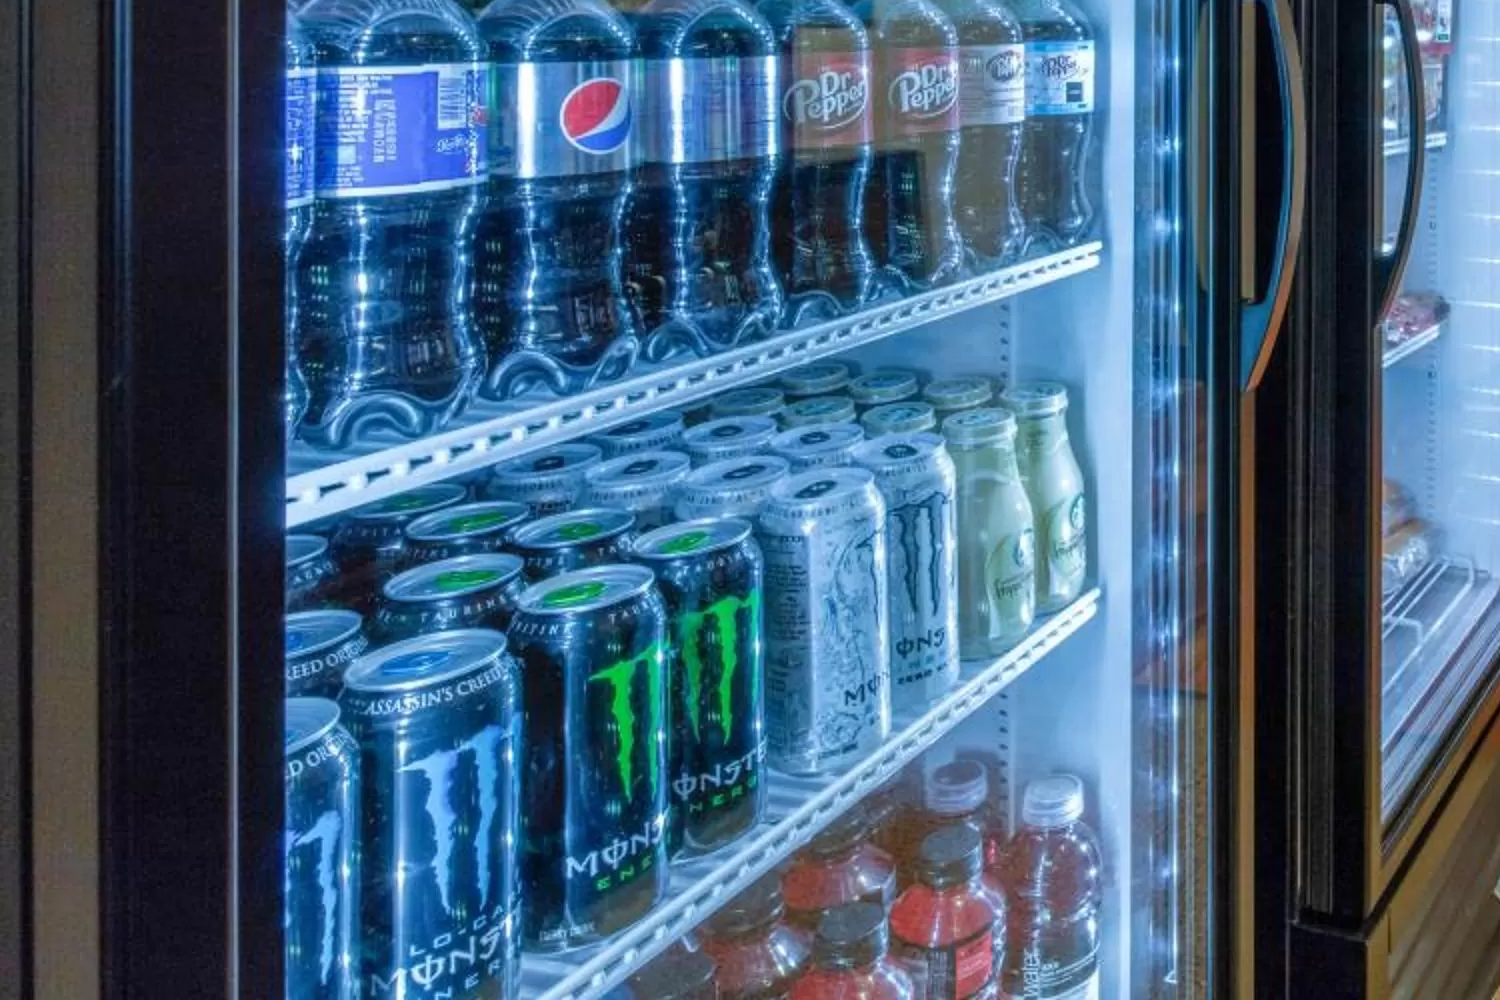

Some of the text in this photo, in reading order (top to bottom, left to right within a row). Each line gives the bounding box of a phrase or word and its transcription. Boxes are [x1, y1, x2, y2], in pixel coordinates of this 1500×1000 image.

[820, 71, 851, 97] Dr
[921, 64, 951, 88] Dr
[365, 686, 454, 716] ASSASSIN'S
